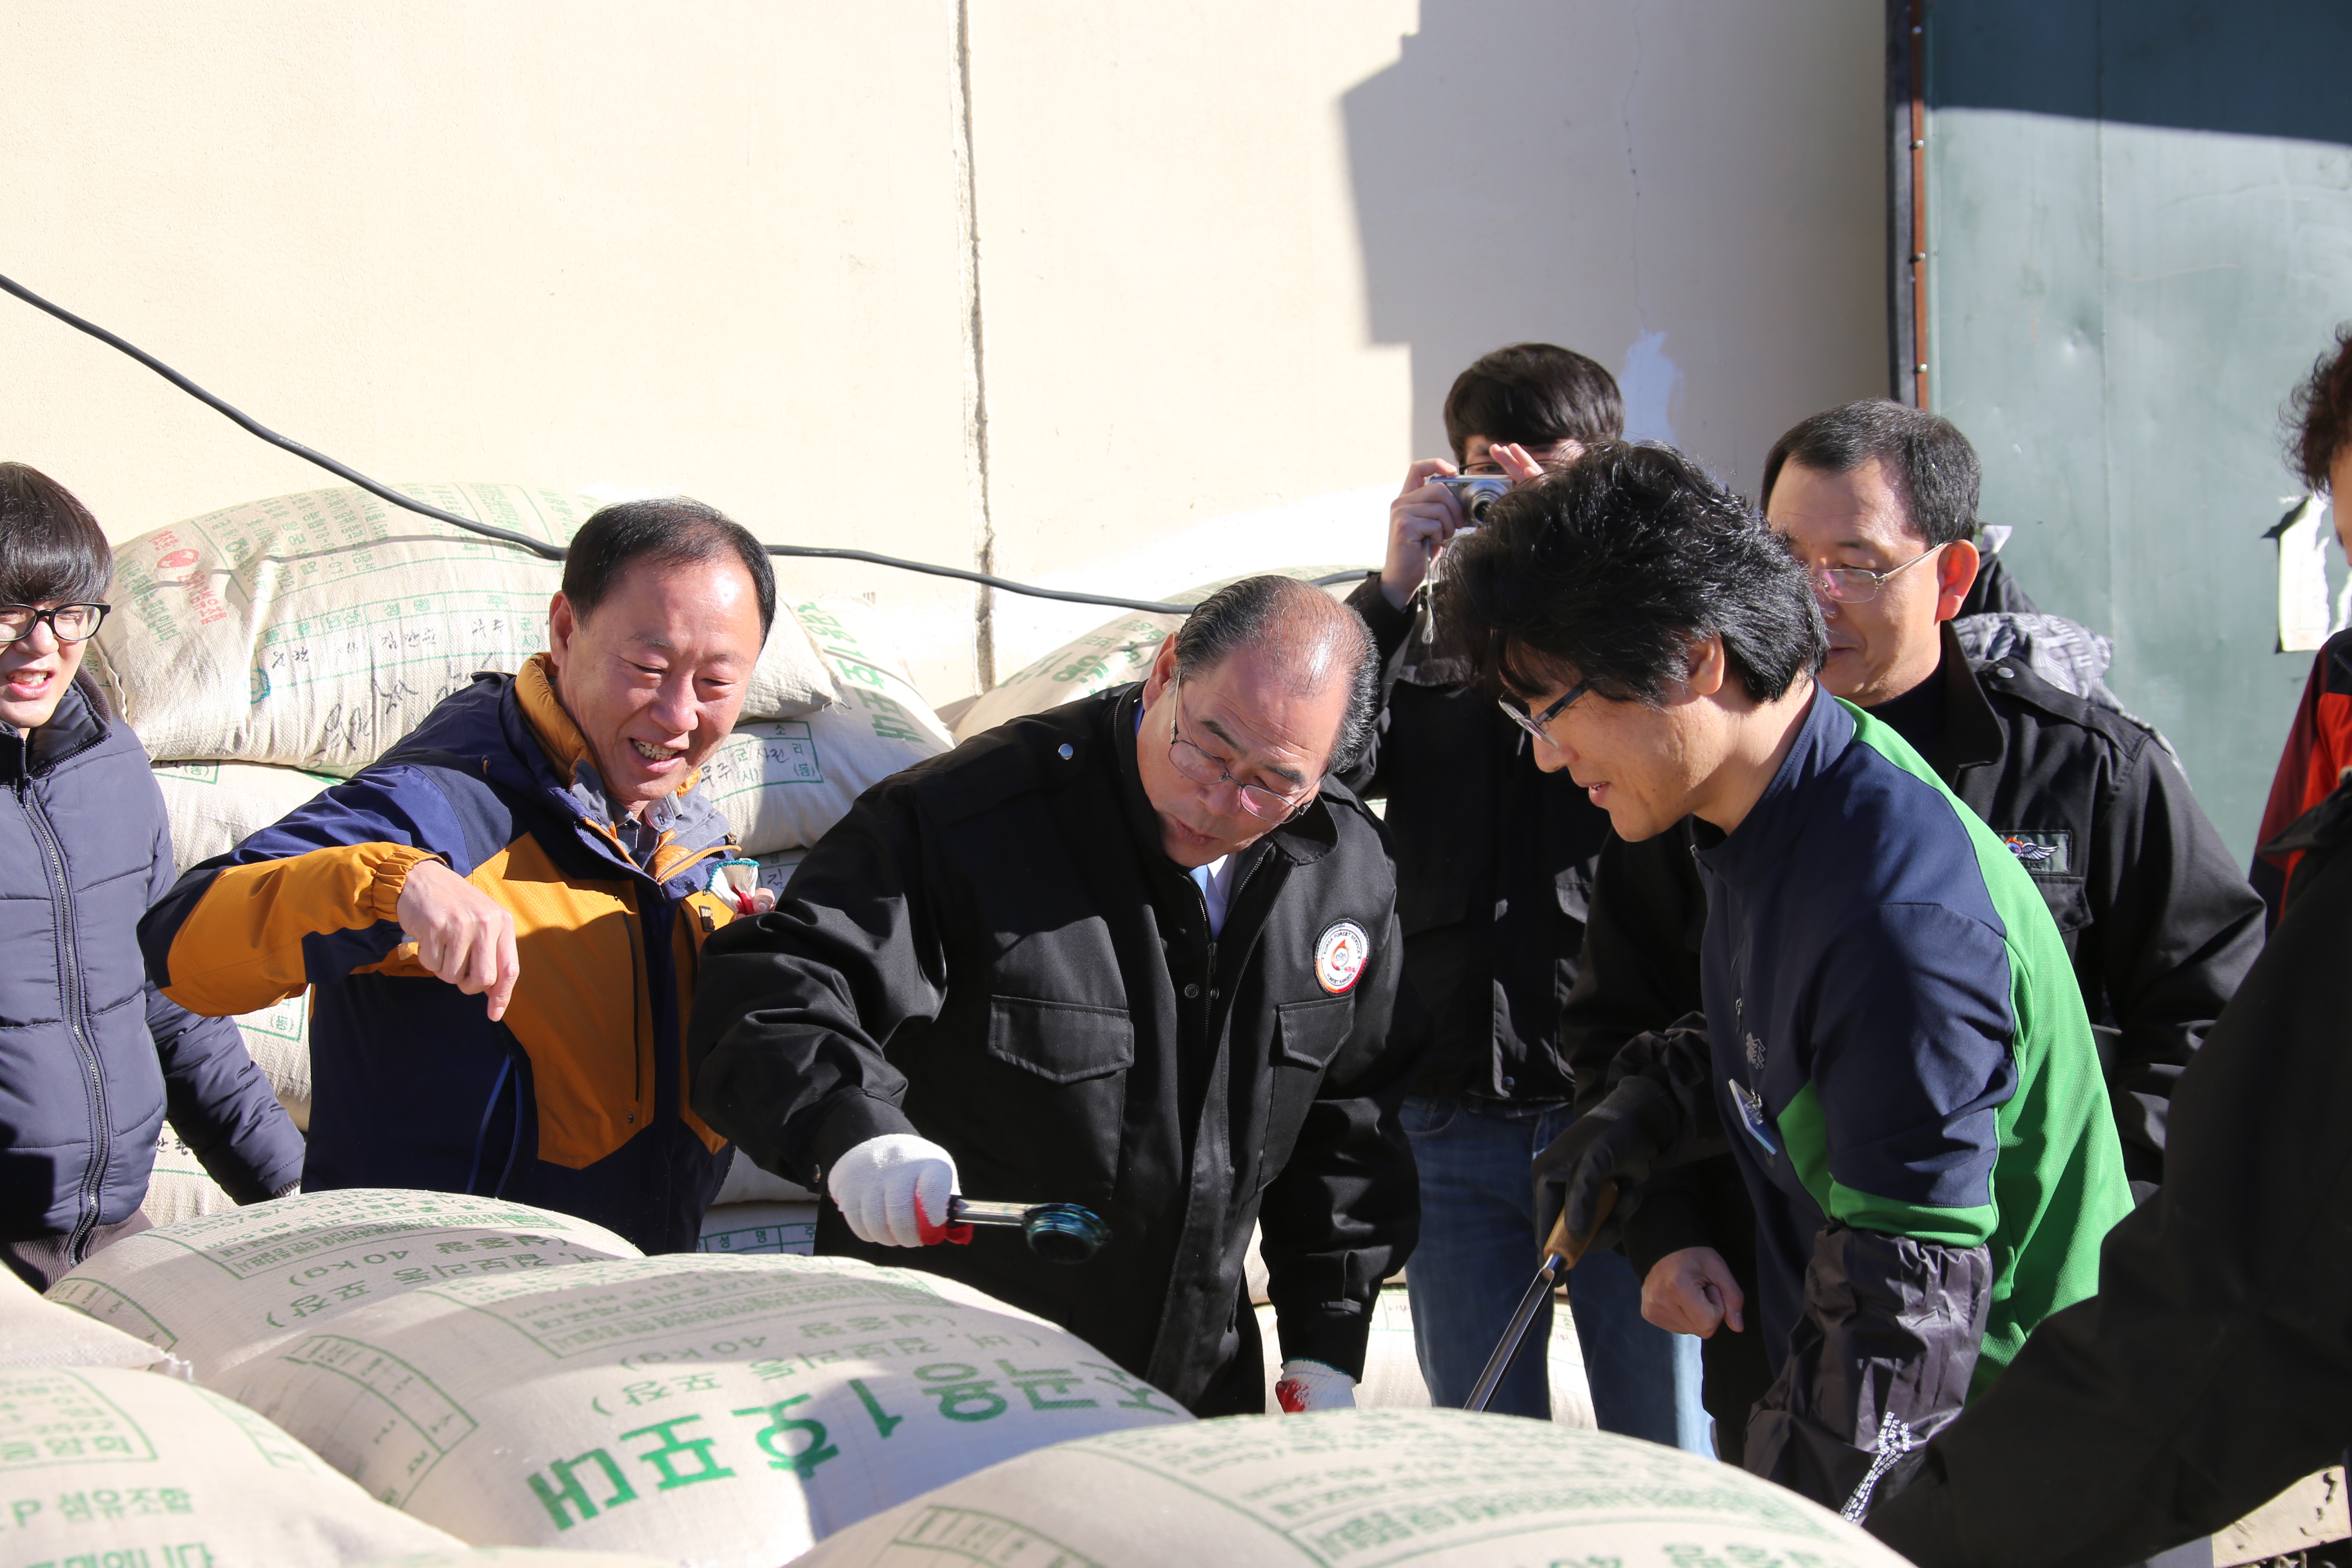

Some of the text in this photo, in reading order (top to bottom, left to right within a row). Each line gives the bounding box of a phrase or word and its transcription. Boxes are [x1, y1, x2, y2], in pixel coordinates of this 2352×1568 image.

[775, 725, 787, 736] 소
[736, 748, 748, 761] 군
[792, 743, 805, 756] 리
[1323, 938, 1333, 955] KOREA
[1351, 935, 1361, 954] SERVICE
[719, 1235, 730, 1249] 성
[756, 1230, 767, 1243] 명
